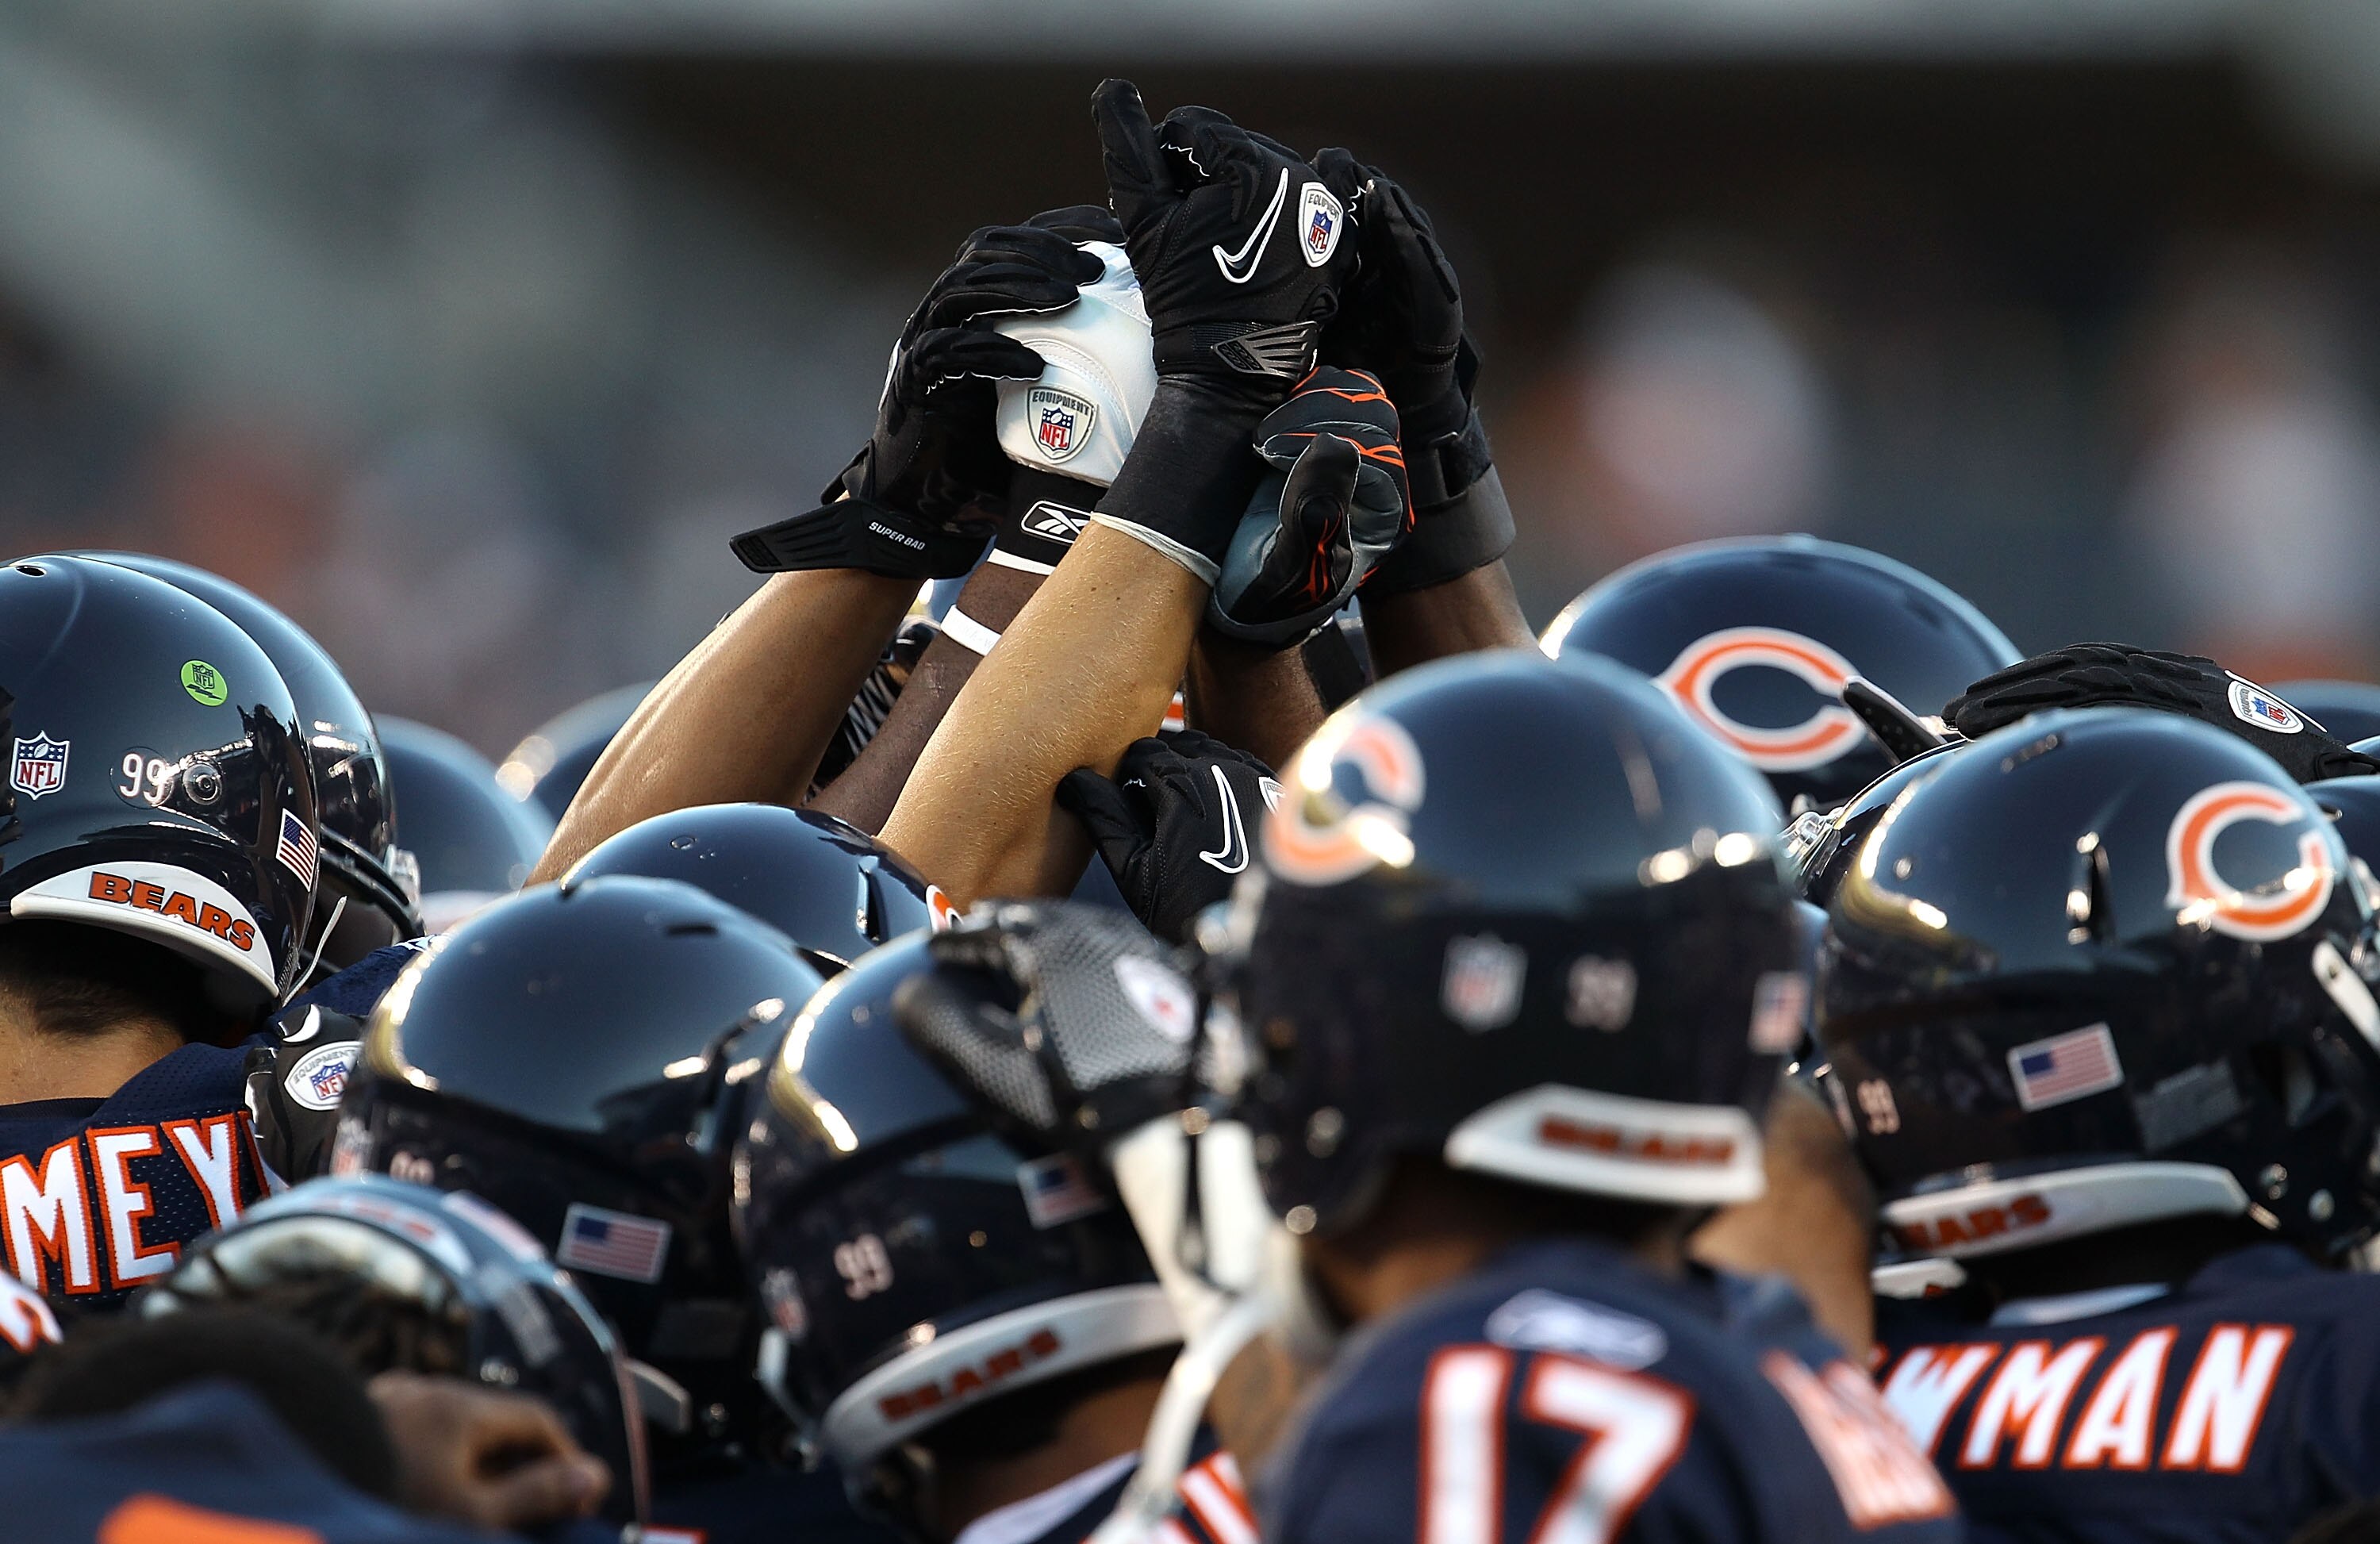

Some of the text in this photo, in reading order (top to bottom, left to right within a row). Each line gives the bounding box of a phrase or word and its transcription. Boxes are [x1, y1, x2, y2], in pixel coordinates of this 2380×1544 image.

[1311, 225, 1327, 249] NFL
[1032, 391, 1089, 416] EQUIPMENT
[1041, 423, 1069, 448] NFL
[869, 521, 926, 551] SUPER BAD
[194, 672, 213, 687] NFL
[18, 760, 58, 789] NFL
[120, 753, 168, 805] 99
[88, 870, 255, 952] BEARS
[0, 1111, 289, 1296] MEY
[1416, 1341, 1696, 1544] 17
